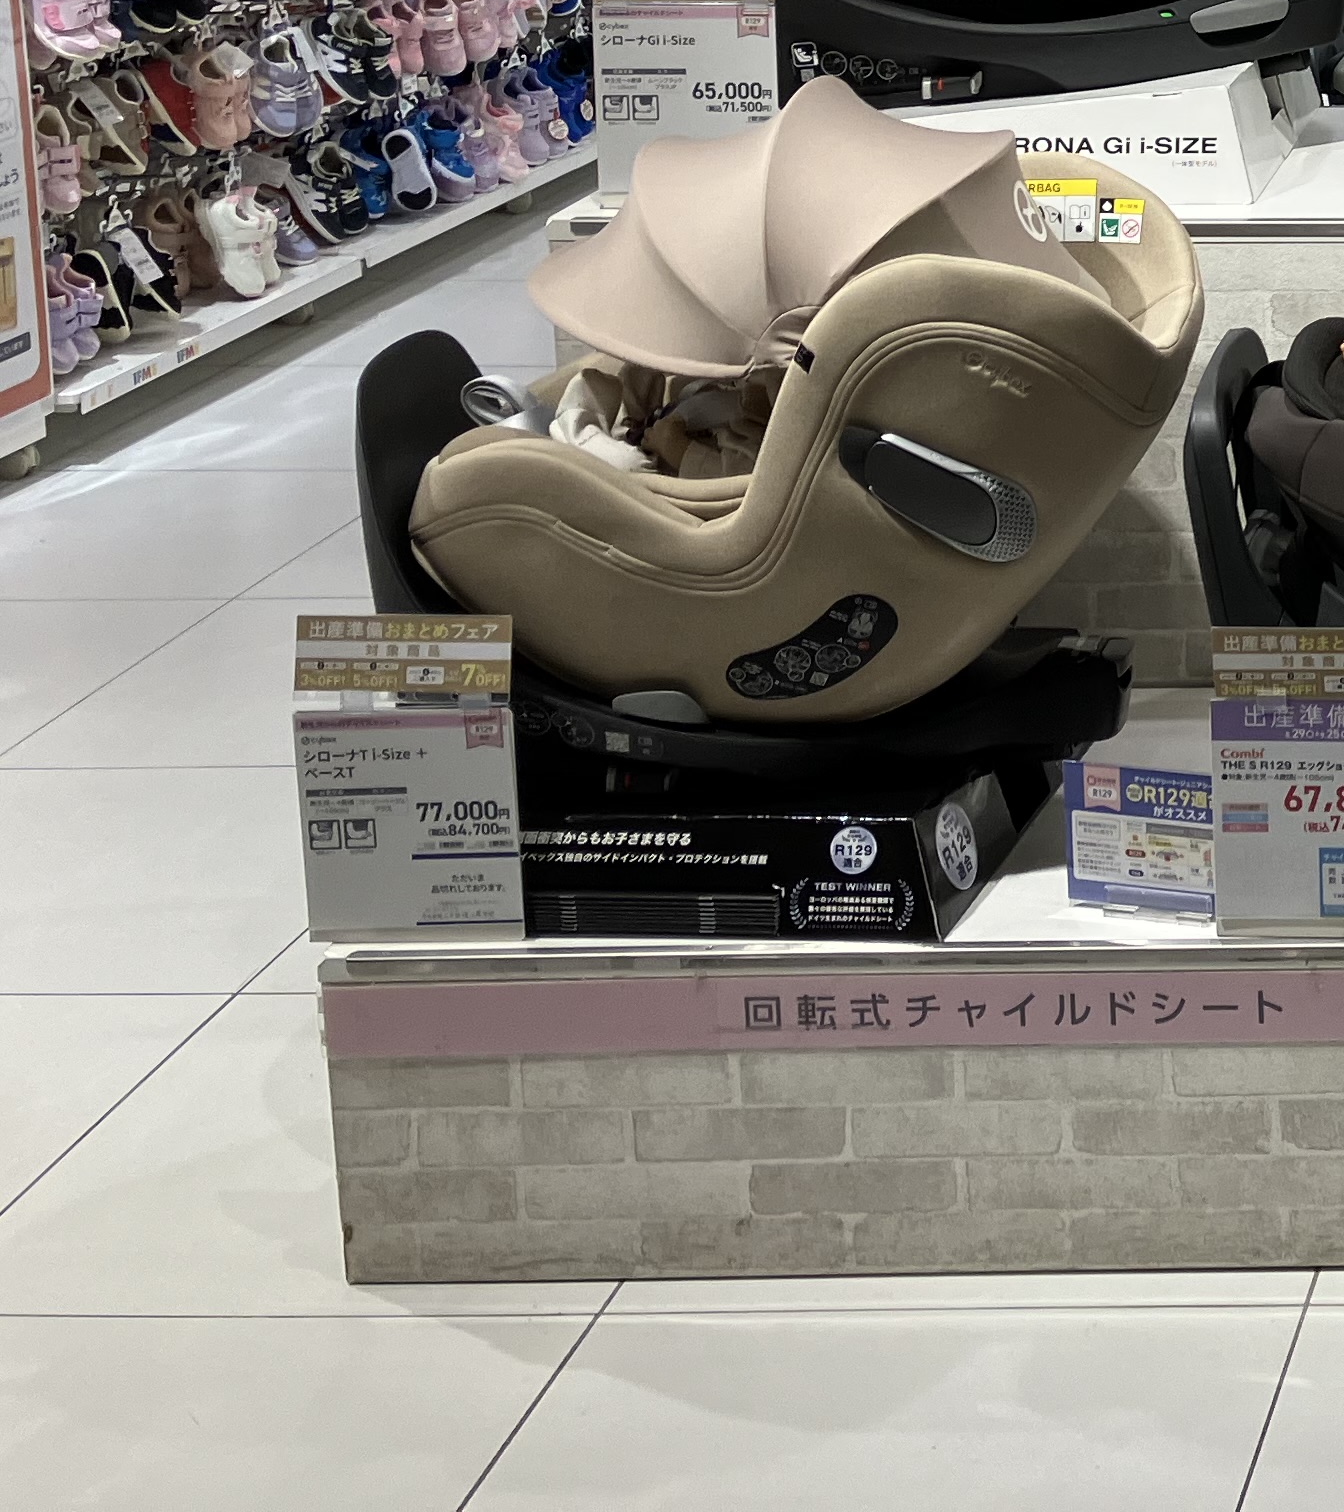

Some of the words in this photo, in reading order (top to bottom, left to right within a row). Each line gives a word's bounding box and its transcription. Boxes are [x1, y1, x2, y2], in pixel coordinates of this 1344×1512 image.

[692, 81, 772, 101] 65,000円
[1103, 136, 1131, 155] Gi
[1140, 136, 1218, 155] i-SIZE
[309, 620, 500, 639] 出産準備おまとめフェア
[1220, 747, 1266, 759] Combi
[304, 764, 356, 779] ベースT
[1220, 760, 1249, 771] THE
[1258, 760, 1293, 771] R129
[1091, 788, 1114, 799] R129
[415, 799, 511, 822] 77,000円
[1152, 806, 1207, 821] がオススメ
[834, 844, 873, 857] R129
[814, 883, 843, 893] TEST
[845, 883, 892, 893] WINNER
[744, 990, 1283, 1031] 回転式チャイルドシート
